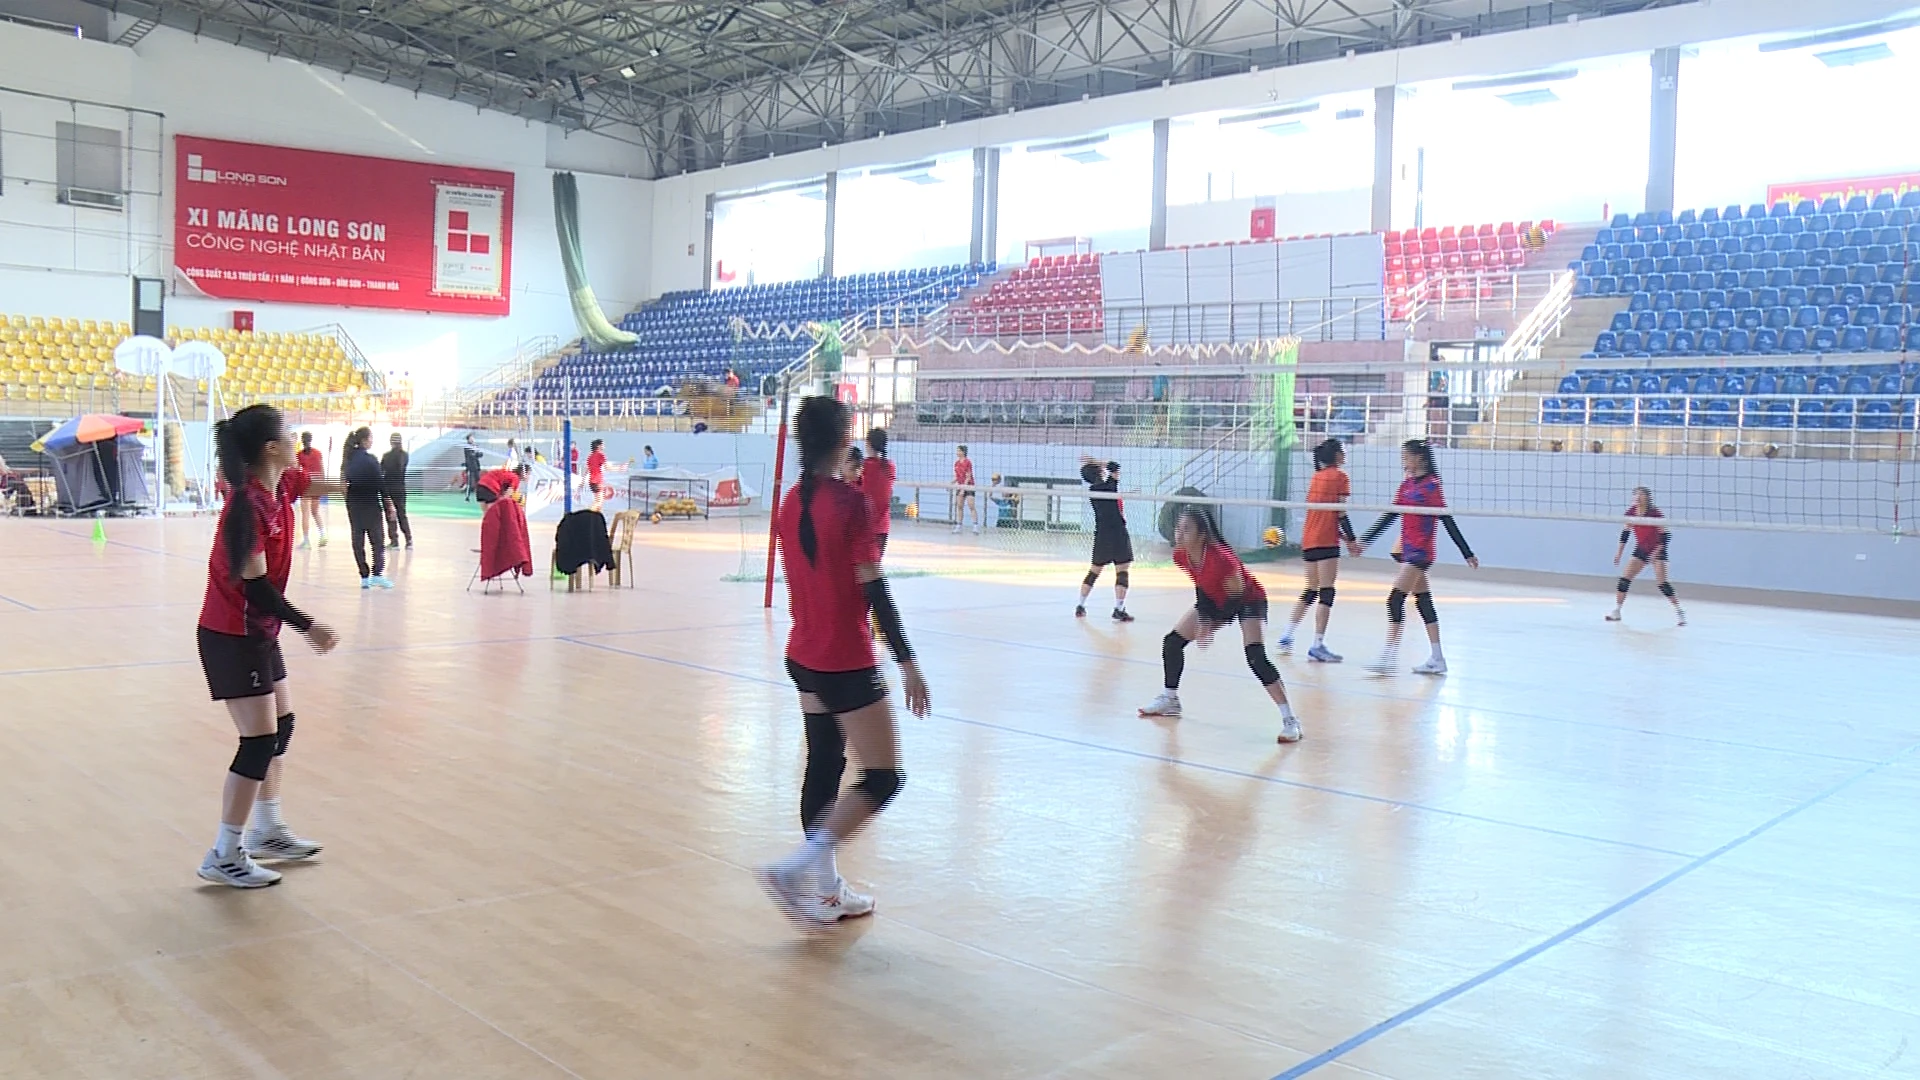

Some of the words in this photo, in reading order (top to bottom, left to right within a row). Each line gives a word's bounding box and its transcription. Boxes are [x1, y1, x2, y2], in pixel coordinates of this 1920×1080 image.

[217, 171, 255, 183] LONG
[187, 207, 209, 227] XI
[217, 208, 279, 233] MĂNG
[287, 216, 340, 238] LONG
[347, 221, 386, 242] SƠN
[186, 232, 245, 251] CÔNG
[250, 239, 300, 258] NGHỆ
[304, 243, 349, 261] NHẬT
[352, 244, 386, 262] BẢN
[250, 670, 261, 688] 2
